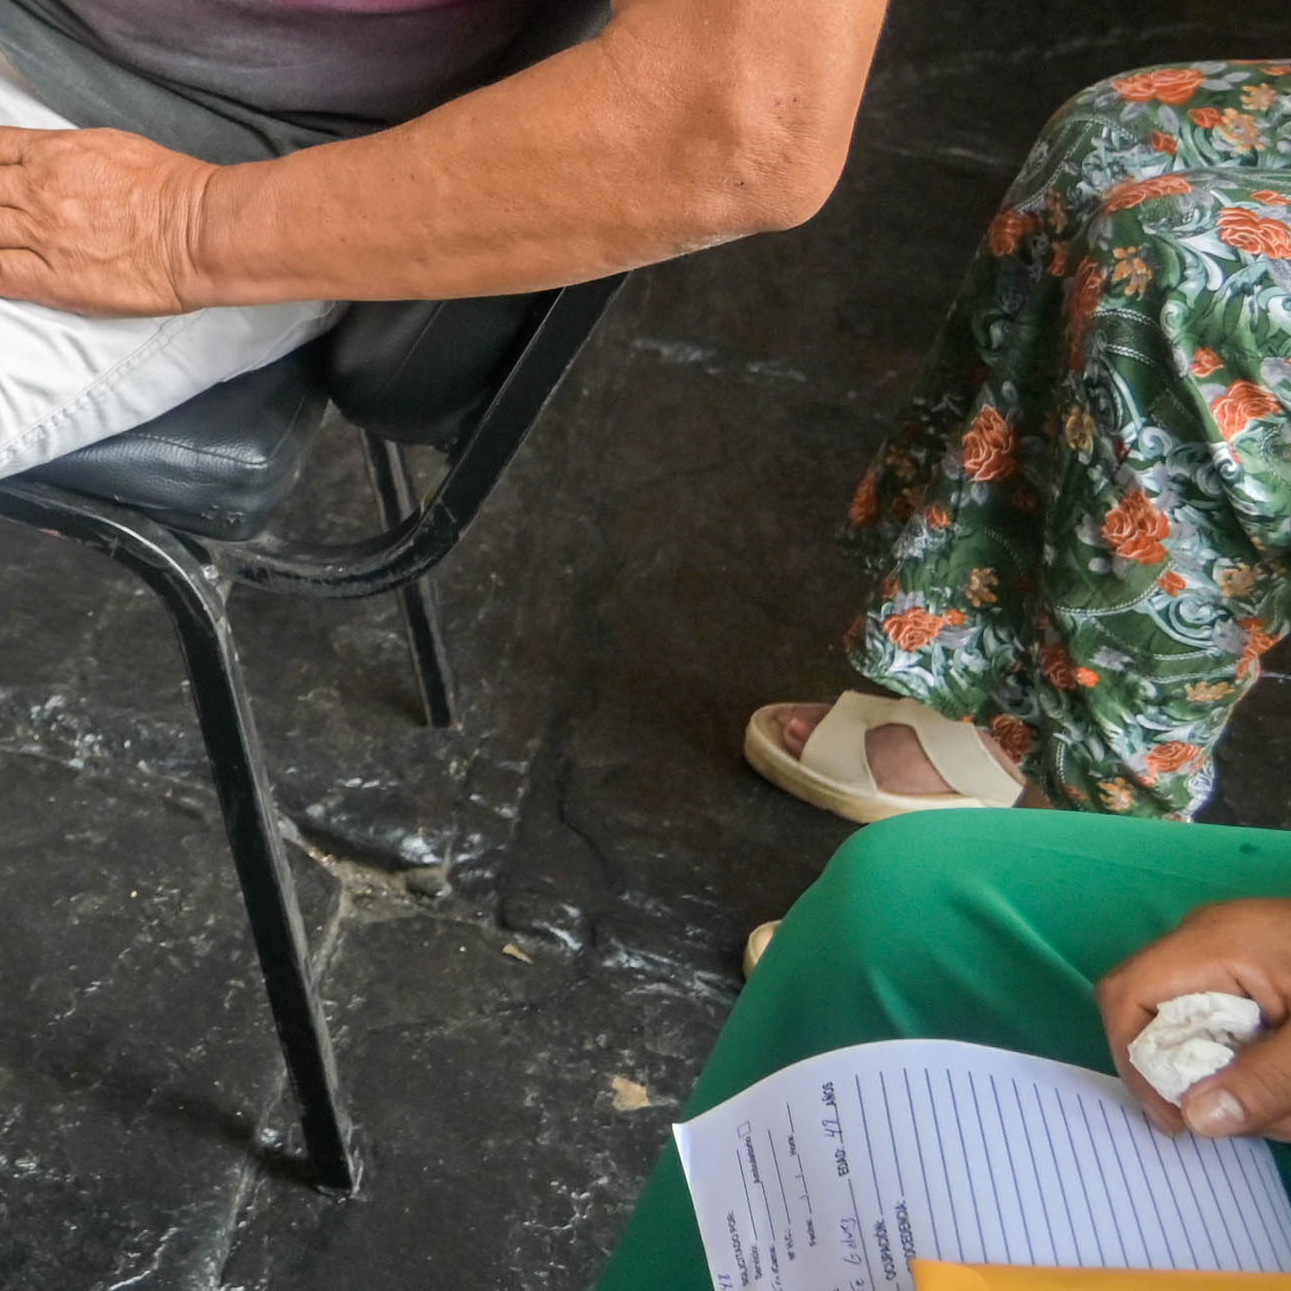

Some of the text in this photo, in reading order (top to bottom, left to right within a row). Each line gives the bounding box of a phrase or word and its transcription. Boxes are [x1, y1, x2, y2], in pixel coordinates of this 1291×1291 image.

[821, 1081, 837, 1106] AÑOS
[834, 1147, 850, 1177] EDAD:
[730, 1233, 749, 1287] SOLICITADO
[872, 1218, 897, 1281] OCUPACIÓN:
[894, 1199, 916, 1272] OCEDENCIA:
